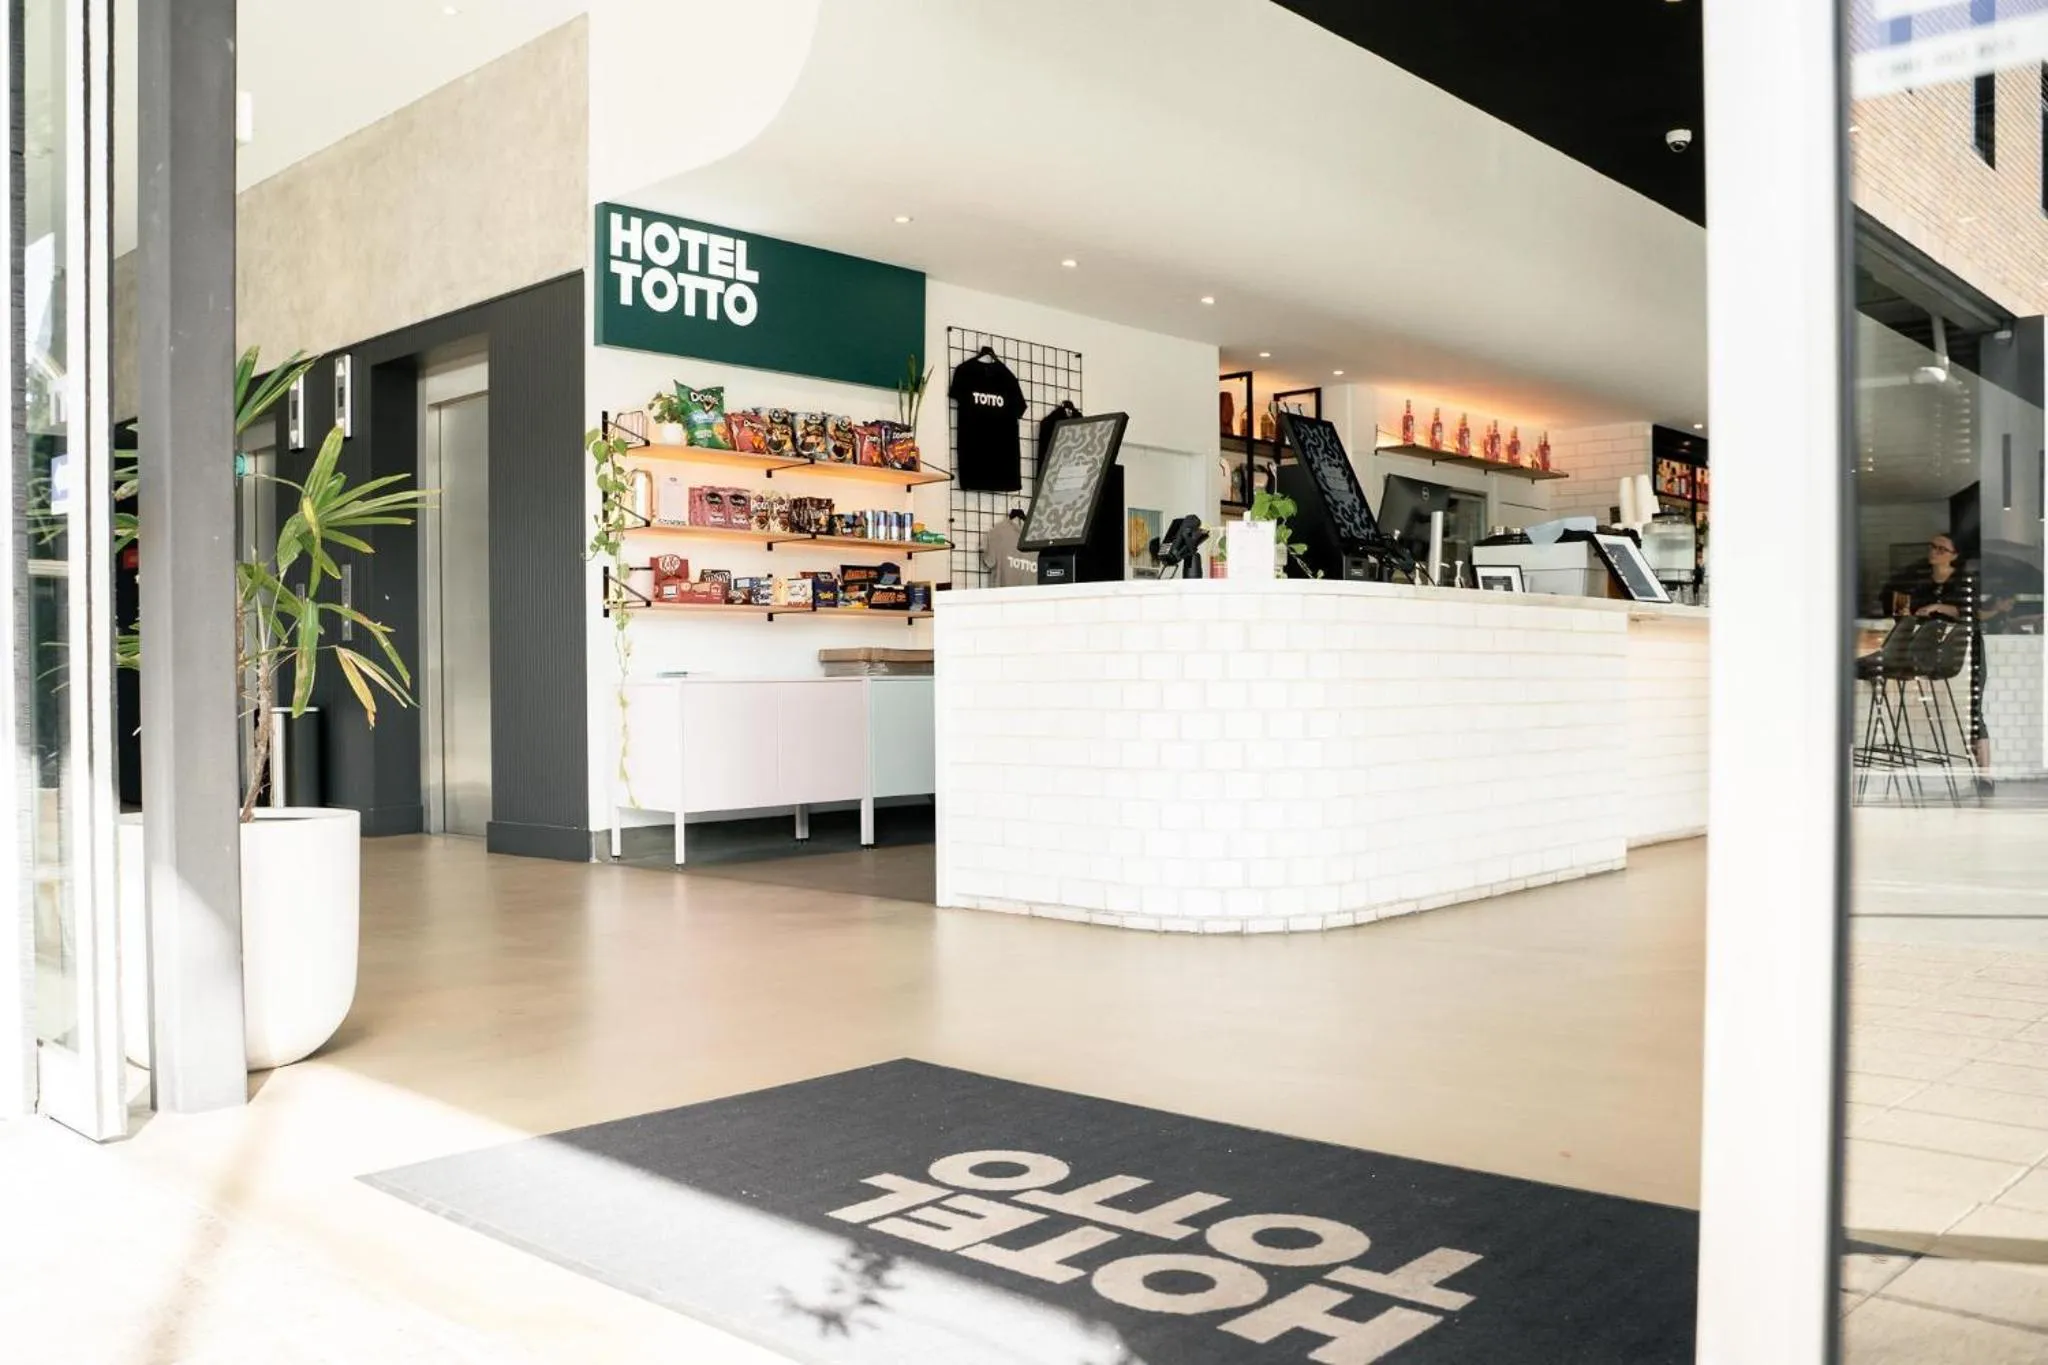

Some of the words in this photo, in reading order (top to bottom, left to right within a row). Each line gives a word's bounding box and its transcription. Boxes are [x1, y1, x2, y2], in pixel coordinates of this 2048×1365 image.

[610, 212, 759, 284] HOTEL
[610, 259, 758, 327] TOTTO
[972, 392, 1005, 408] TOTTO
[1007, 556, 1038, 573] TOTTO
[928, 1150, 1484, 1311] TOTTO
[825, 1173, 1444, 1365] HOTEL
